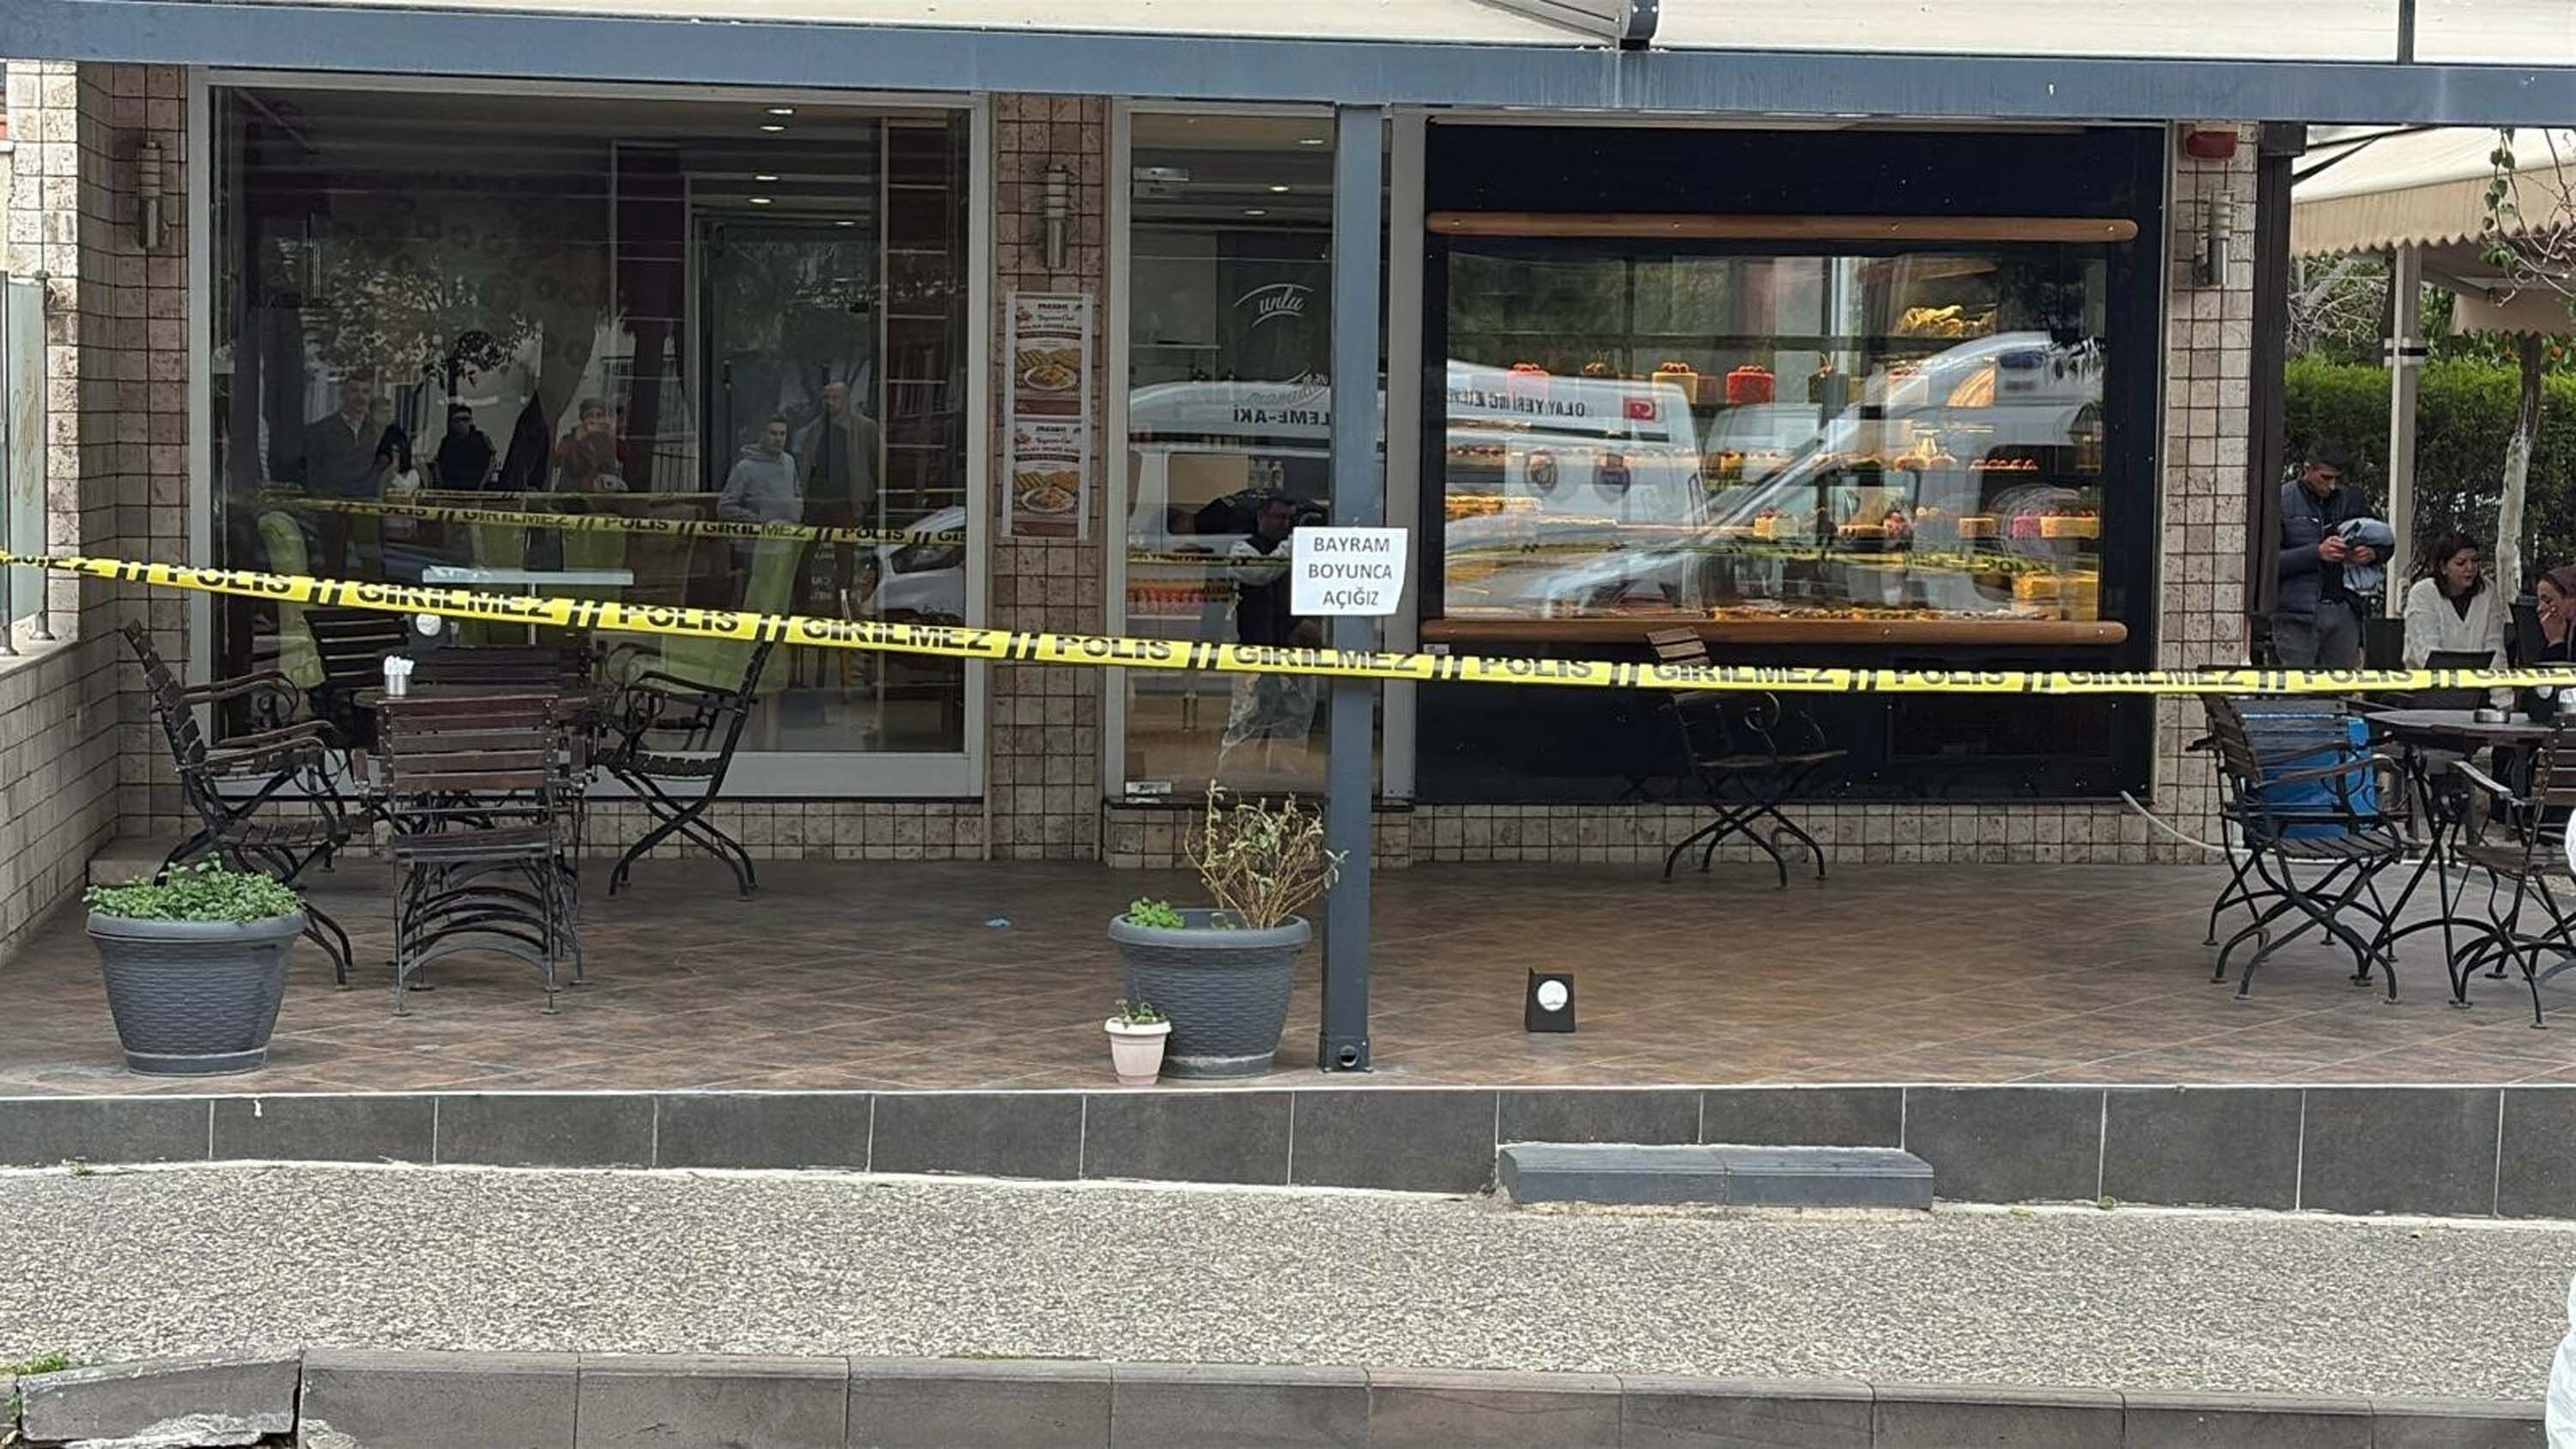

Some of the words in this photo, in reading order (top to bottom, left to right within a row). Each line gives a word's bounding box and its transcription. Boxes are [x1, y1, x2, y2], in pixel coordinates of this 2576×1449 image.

[1314, 537, 1389, 552] BAYRAM
[1309, 564, 1392, 579] BOYUNCA
[1323, 586, 1379, 609] AÇIĞIZ
